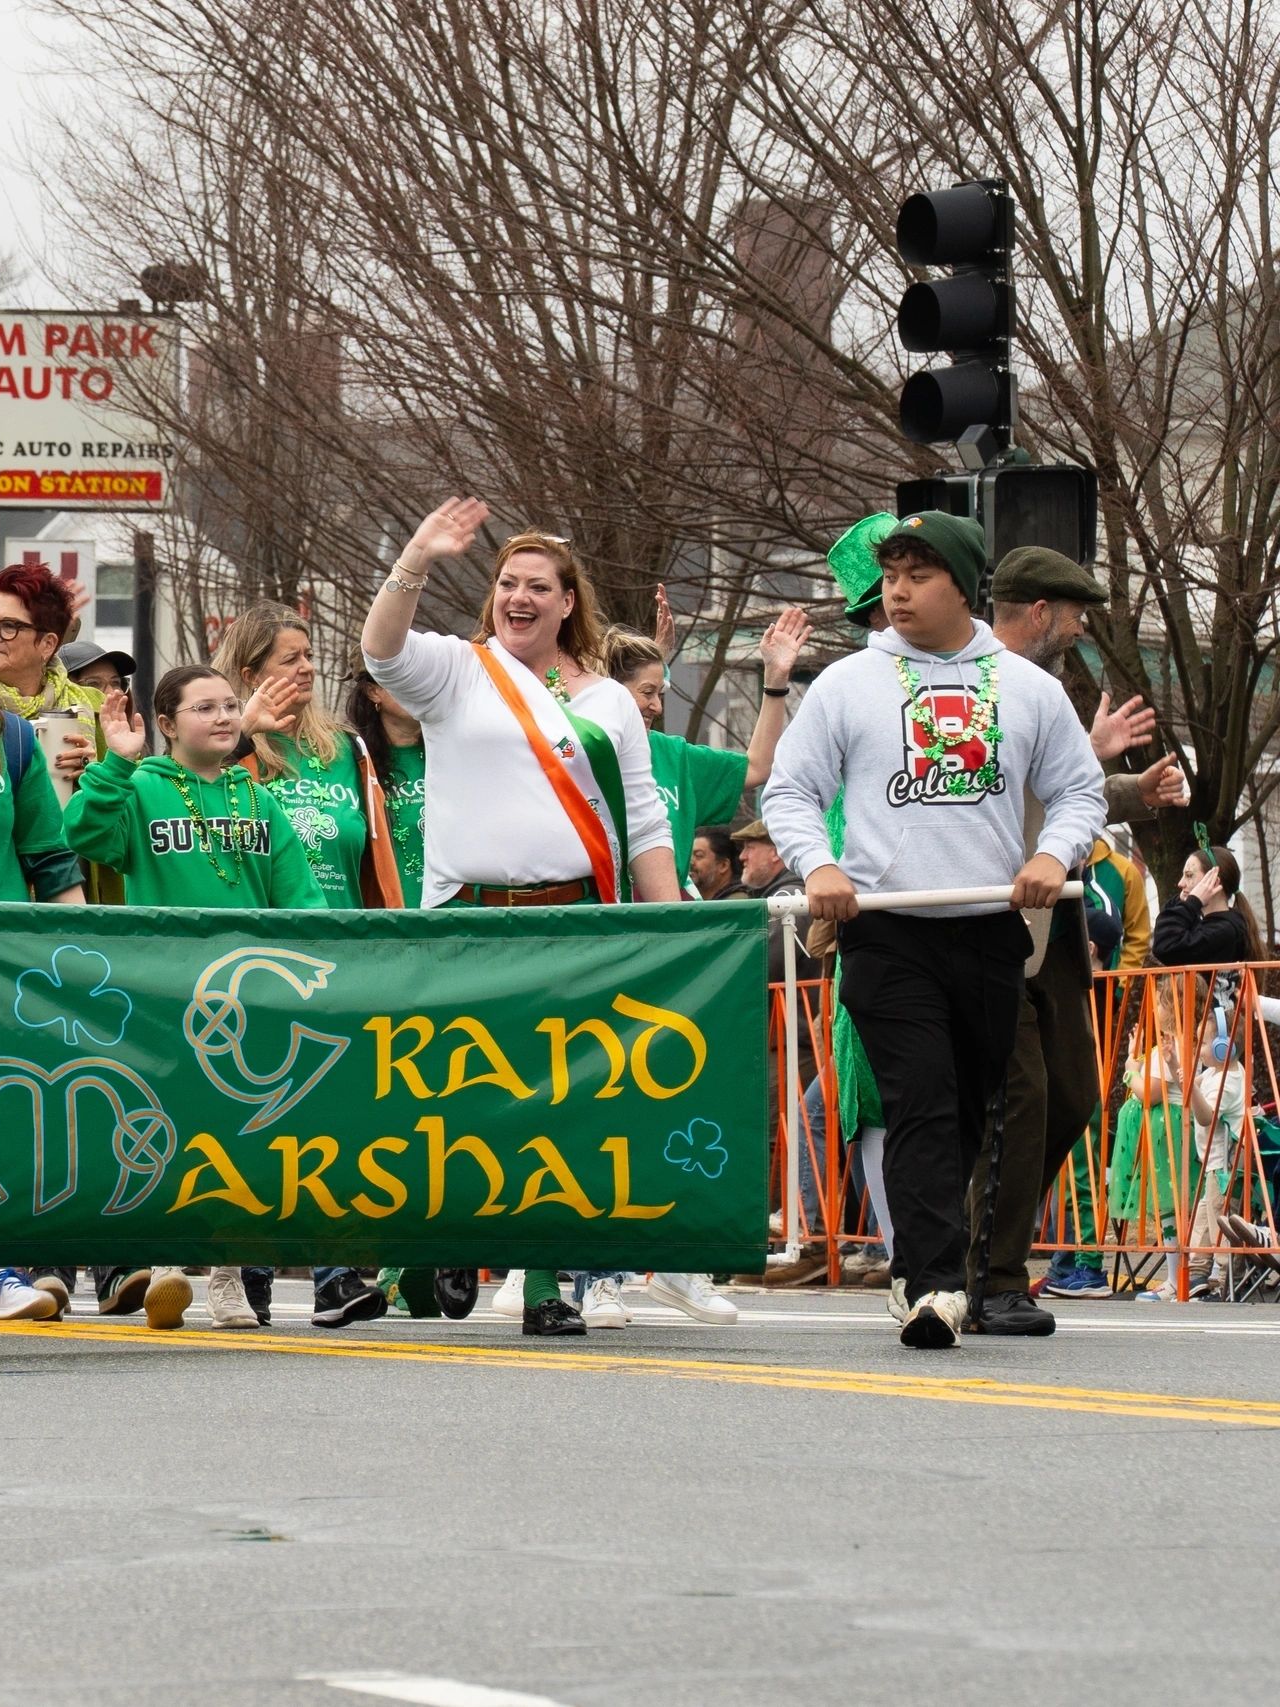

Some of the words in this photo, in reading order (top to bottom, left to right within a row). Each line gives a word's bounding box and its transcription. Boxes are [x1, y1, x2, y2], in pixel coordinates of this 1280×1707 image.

[44, 323, 160, 359] PARK
[14, 440, 73, 459] AUTO
[80, 441, 175, 460] REPAIRS
[39, 474, 149, 495] STATION
